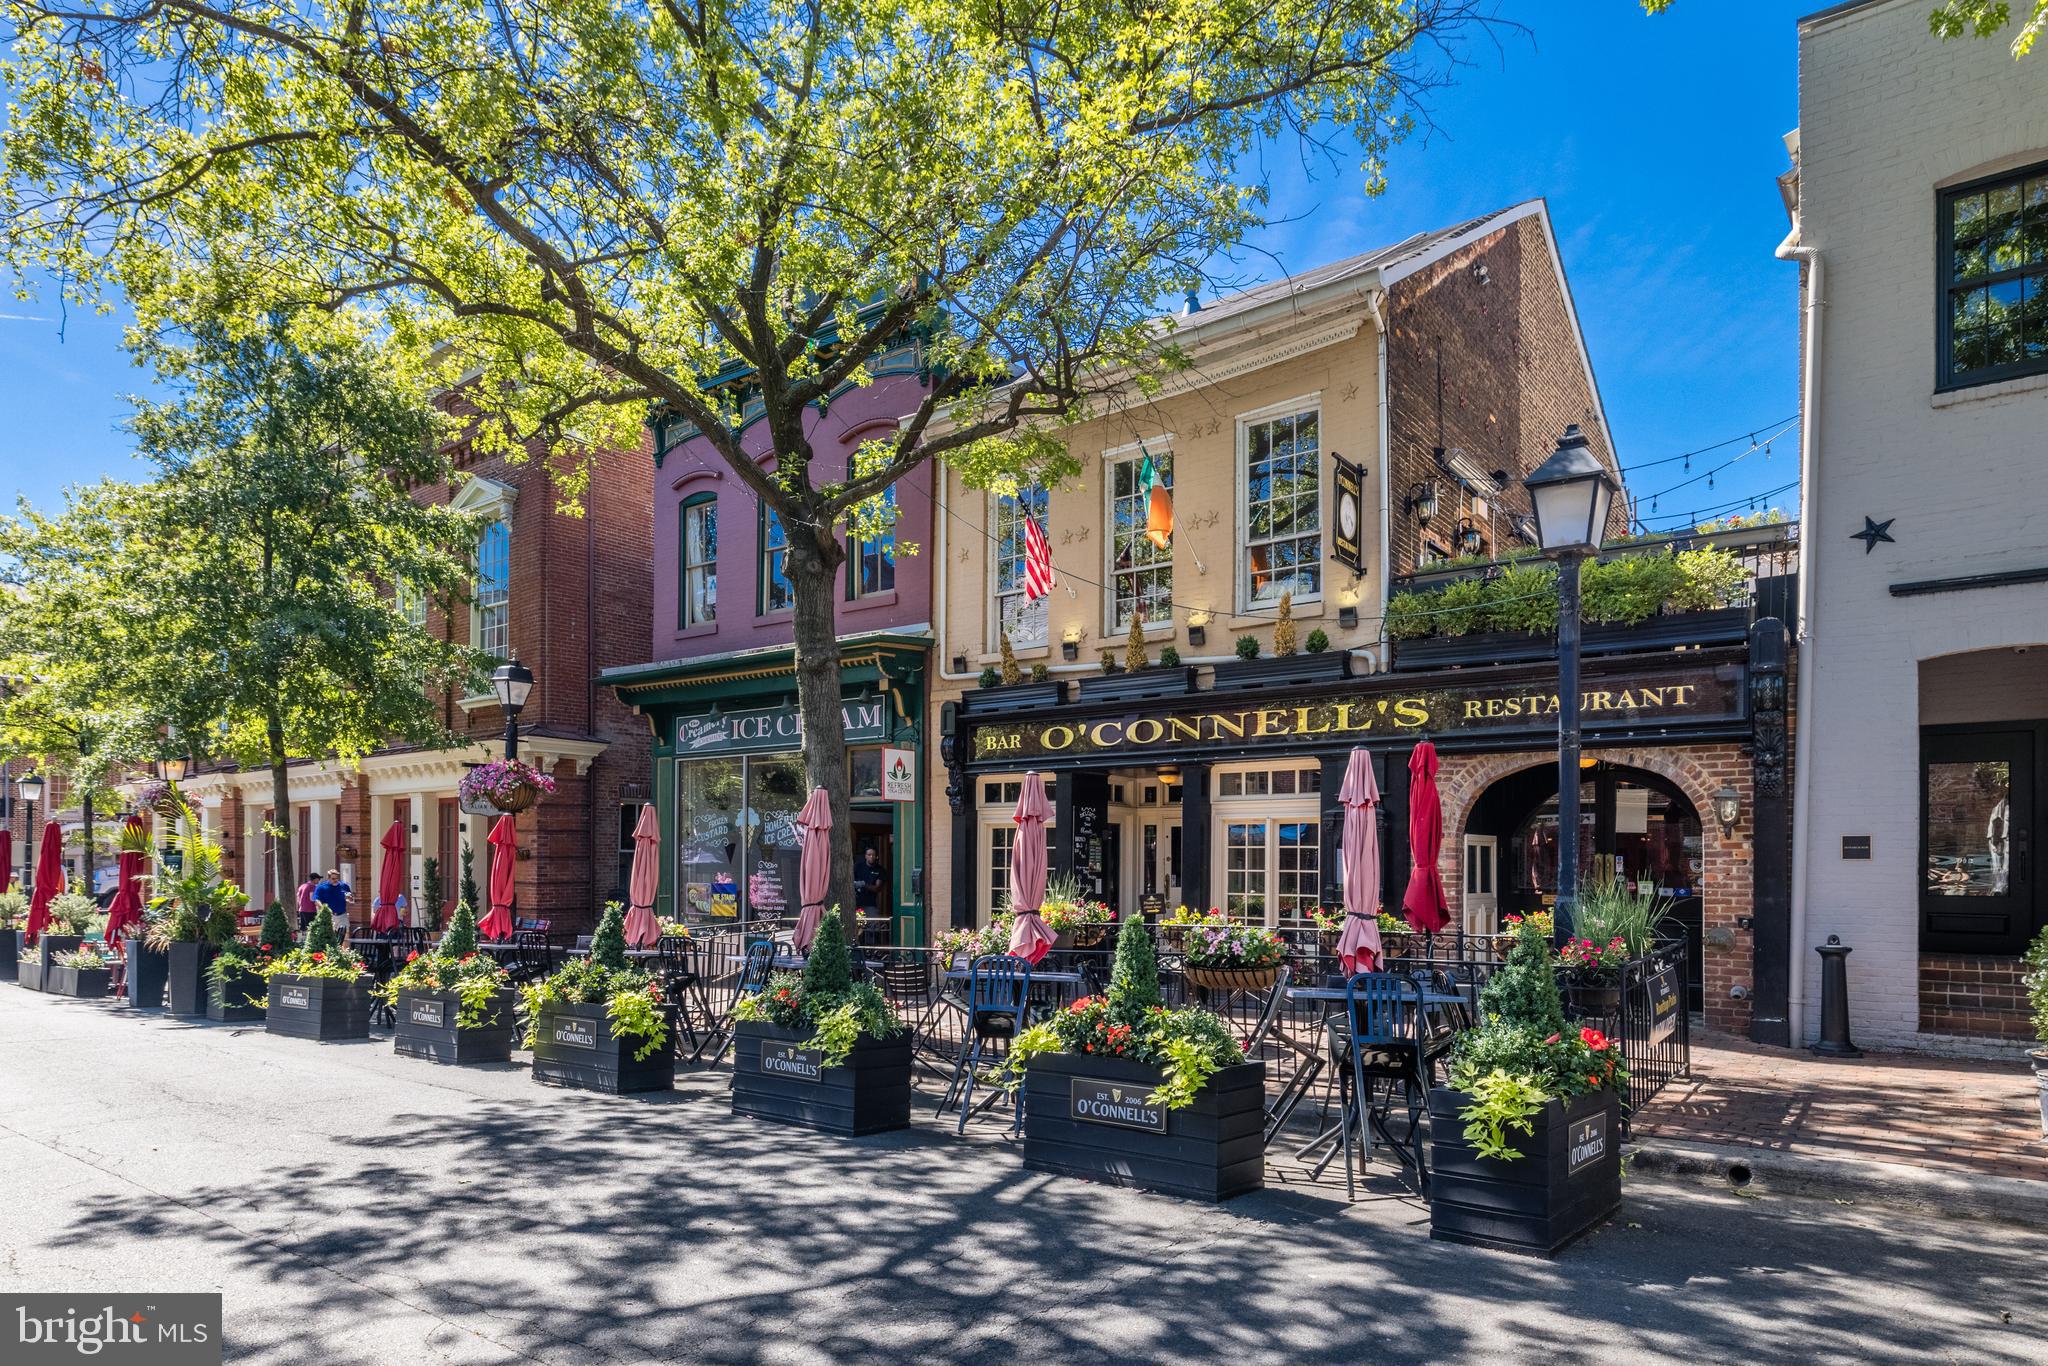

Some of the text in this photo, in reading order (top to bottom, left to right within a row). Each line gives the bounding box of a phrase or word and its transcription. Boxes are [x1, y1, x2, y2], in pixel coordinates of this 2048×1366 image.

[730, 714, 772, 740] ICE
[777, 704, 881, 736] CAM
[986, 734, 1022, 751] BAR
[1040, 698, 1429, 750] O'CONNELL'S
[708, 816, 729, 829] FROZEN
[764, 811, 801, 833] HOMEMAD
[695, 826, 729, 843] CUSTARD
[765, 833, 776, 845] ICE
[413, 1011, 441, 1024] O'CONNELL'S
[556, 1030, 593, 1045] O'CONNELL'S
[765, 1057, 817, 1076] O'CONNELL'S
[1097, 1092, 1142, 1105] EST. 2006
[1078, 1099, 1158, 1124] O'CONNELL'S
[1571, 1137, 1603, 1166] O'CONNELL'S
